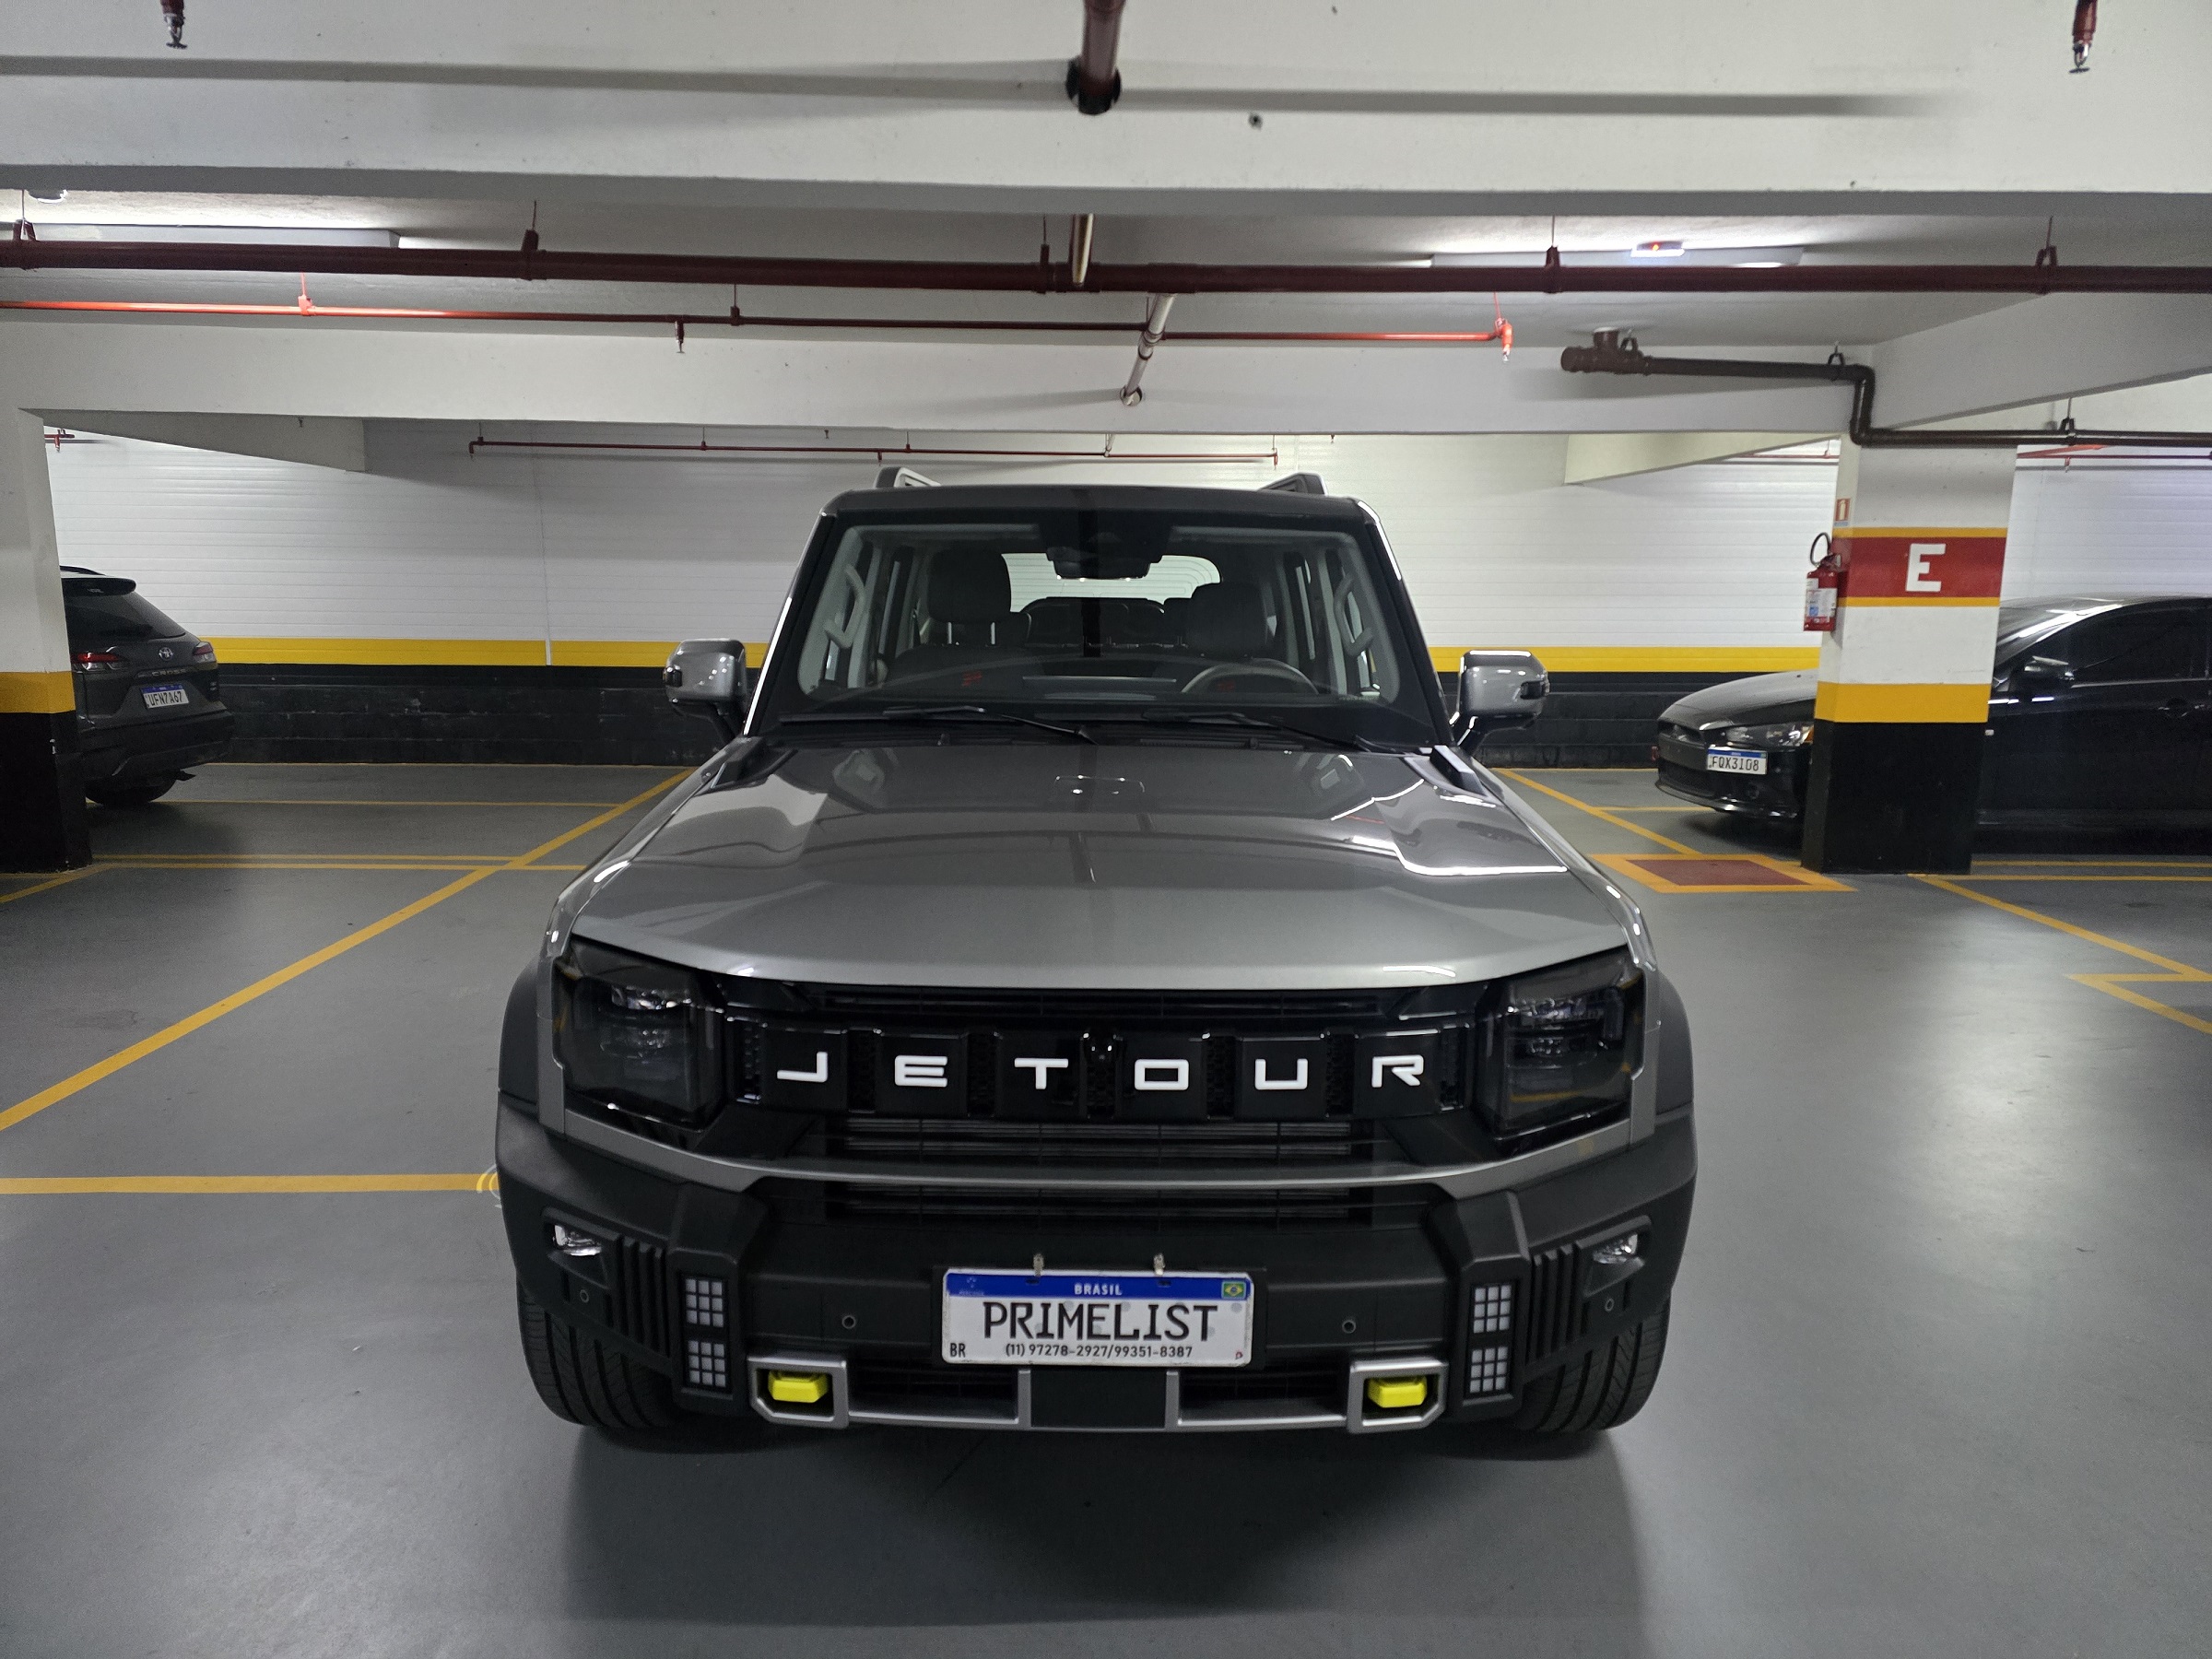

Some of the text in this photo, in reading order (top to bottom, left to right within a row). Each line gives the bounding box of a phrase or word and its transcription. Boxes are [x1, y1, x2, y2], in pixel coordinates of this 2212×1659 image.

[1905, 543, 1947, 593] E
[147, 691, 182, 706] UFN7A67
[776, 1051, 1425, 1090] JETOUR
[1074, 1283, 1123, 1296] BRASIL
[982, 1301, 1218, 1341] PRIMELIST
[949, 1343, 966, 1358] BR
[1005, 1343, 1193, 1359] (11) 97278-2927/99351-8387
